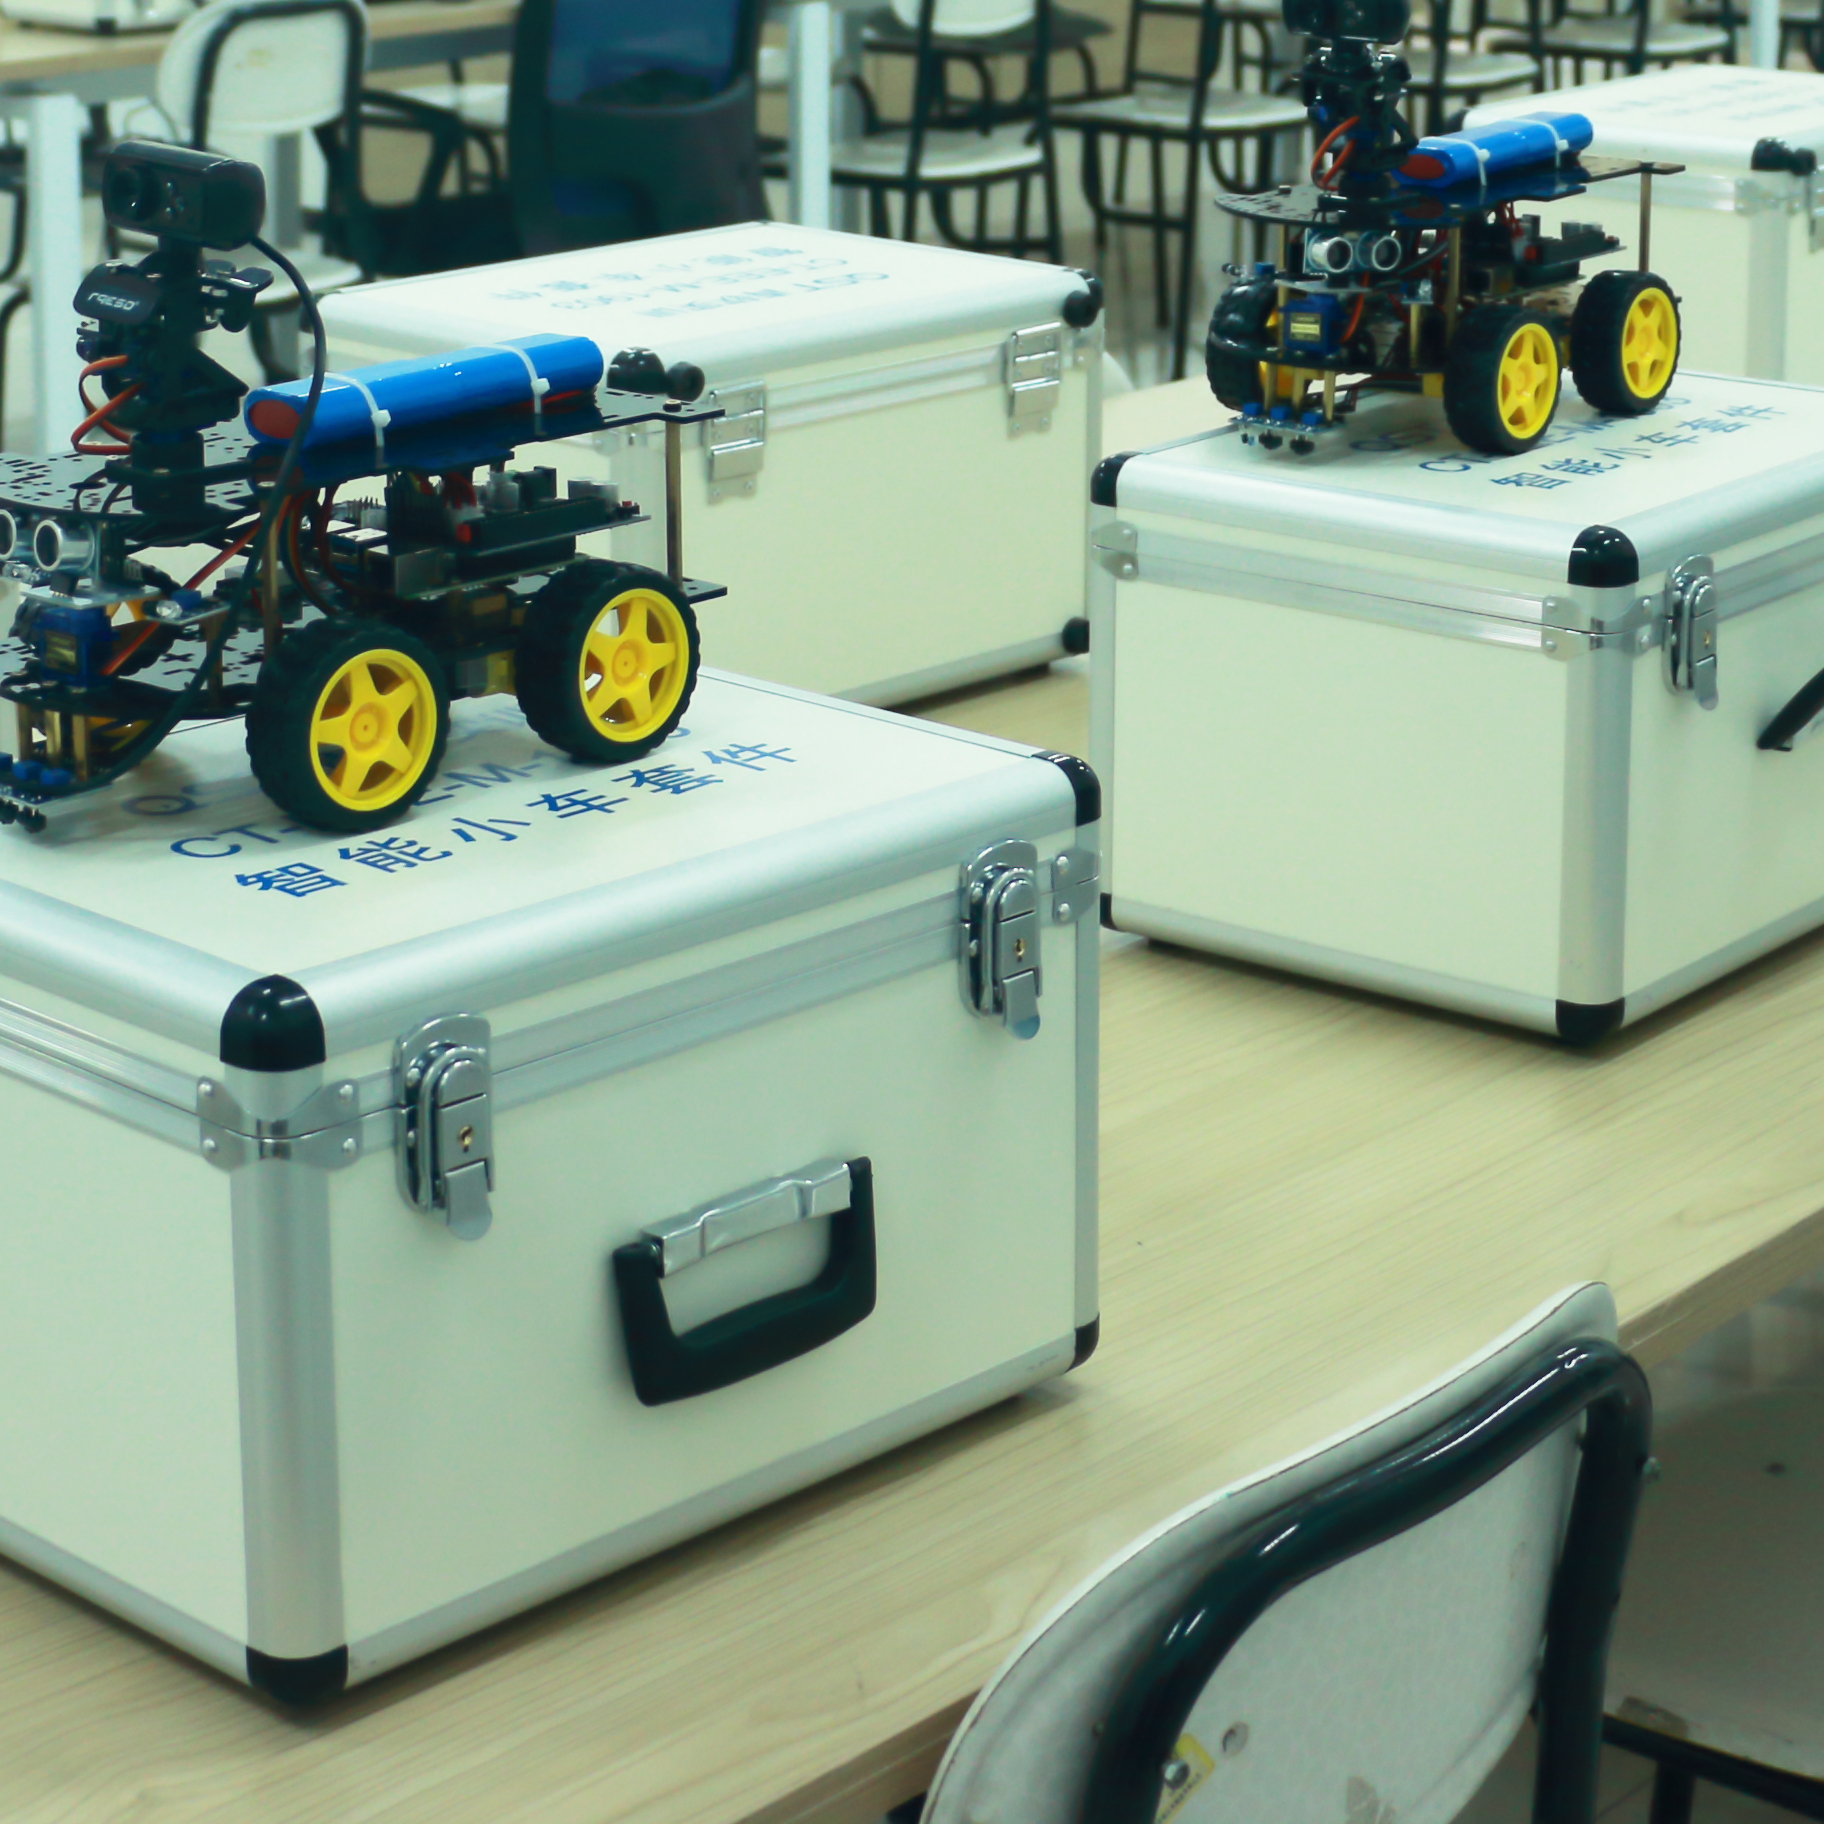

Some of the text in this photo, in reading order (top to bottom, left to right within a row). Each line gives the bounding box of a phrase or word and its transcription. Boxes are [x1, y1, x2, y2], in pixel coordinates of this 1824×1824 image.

[235, 743, 798, 898] 智能小车套件
